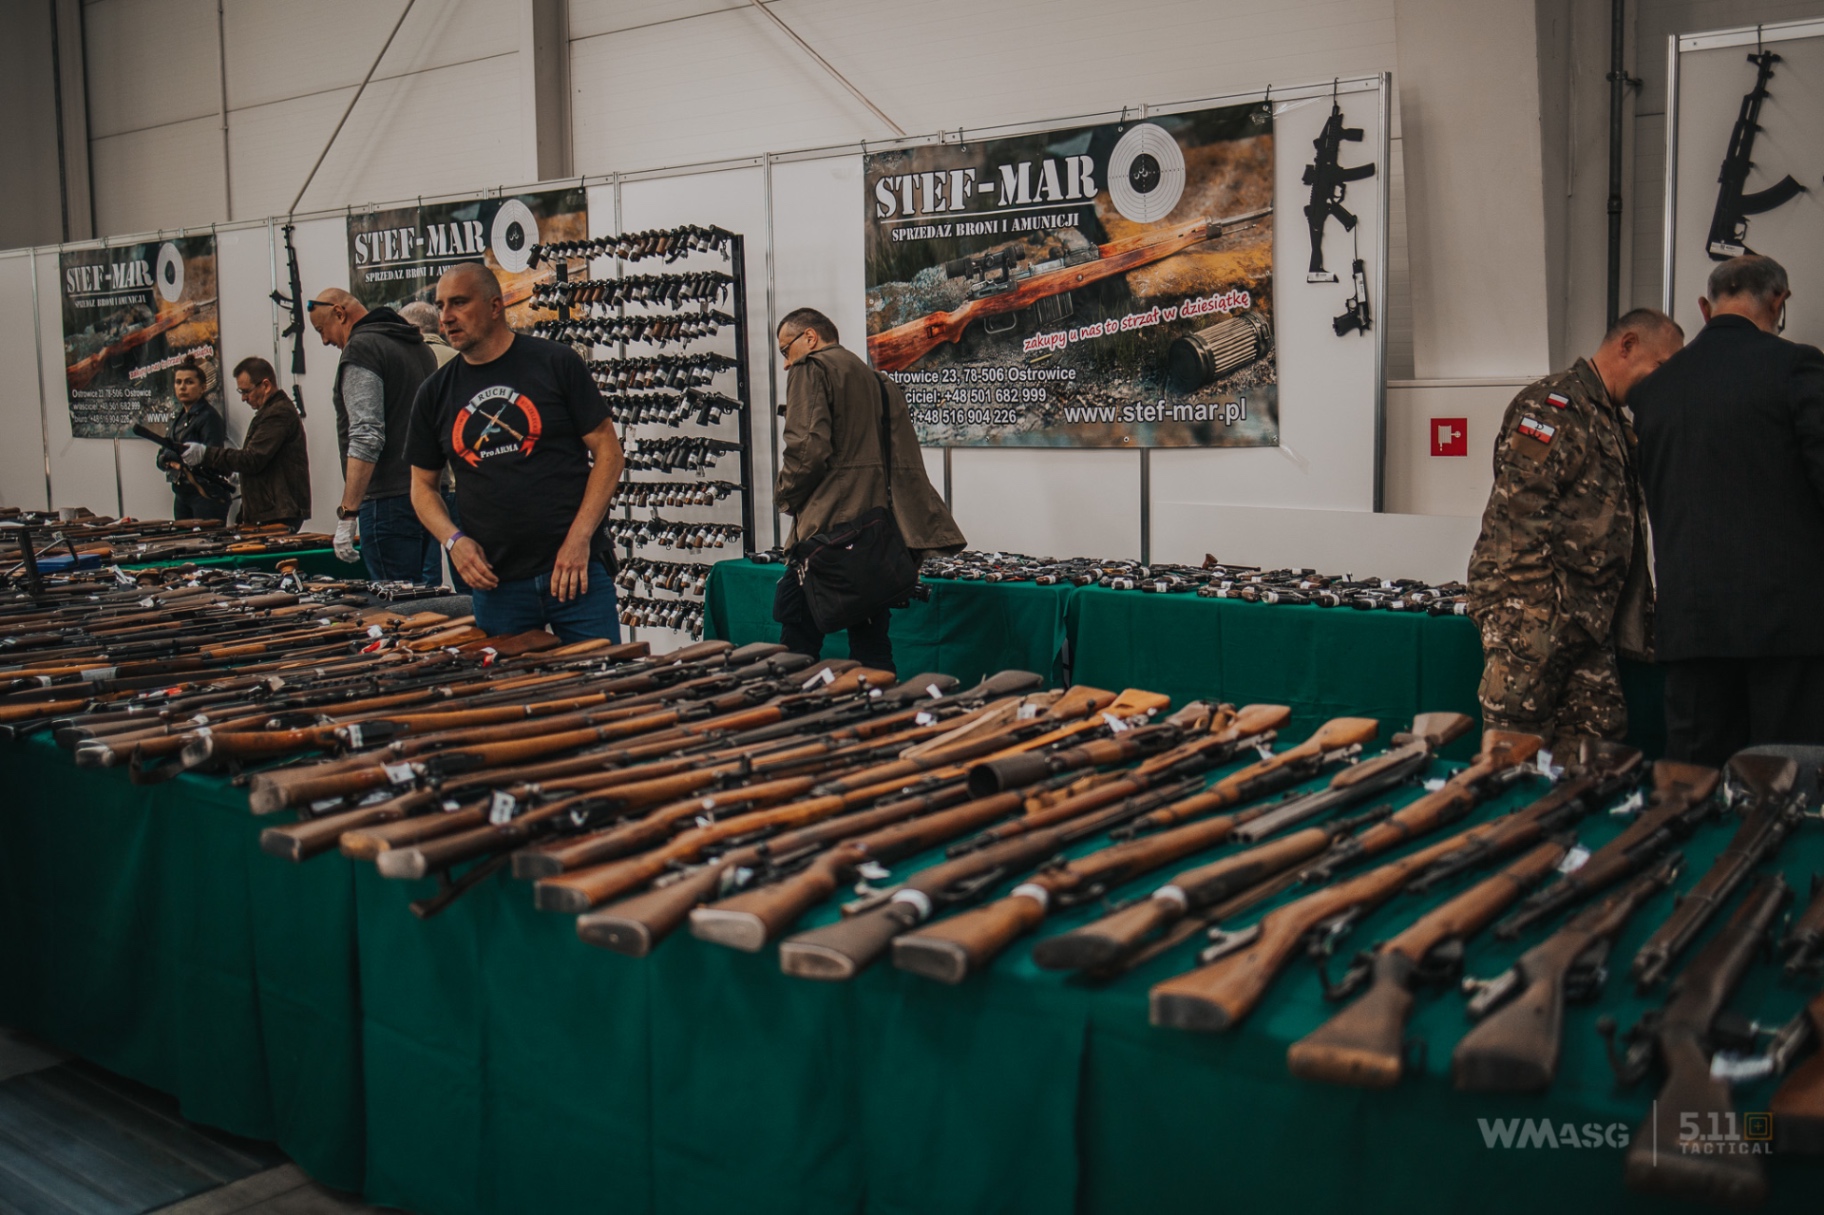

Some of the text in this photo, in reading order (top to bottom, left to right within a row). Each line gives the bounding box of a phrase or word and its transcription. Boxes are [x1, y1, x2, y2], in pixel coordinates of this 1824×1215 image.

[875, 155, 1098, 218] STEF-MAR
[892, 212, 1079, 242] SPRZEDAŻ BRONI I AMUNICJI
[354, 220, 486, 264] STEF-MAR
[67, 260, 154, 293] STEF-MAR
[406, 266, 426, 278] BRONI
[1023, 289, 1251, 352] zakupy u nas to strzał w dziesiątkę
[941, 368, 960, 385] 23,
[964, 368, 1004, 382] 78-506
[1008, 366, 1076, 382] Ostrowice
[124, 388, 152, 398] Ostrowice
[478, 388, 506, 401] RUCH
[905, 388, 1047, 404] ciciel: +48 501 682 999
[917, 410, 938, 424] +48
[942, 410, 965, 424] 516
[967, 409, 990, 424] 904
[992, 408, 1017, 424] 226
[1064, 398, 1246, 426] www.stef-mar.pl
